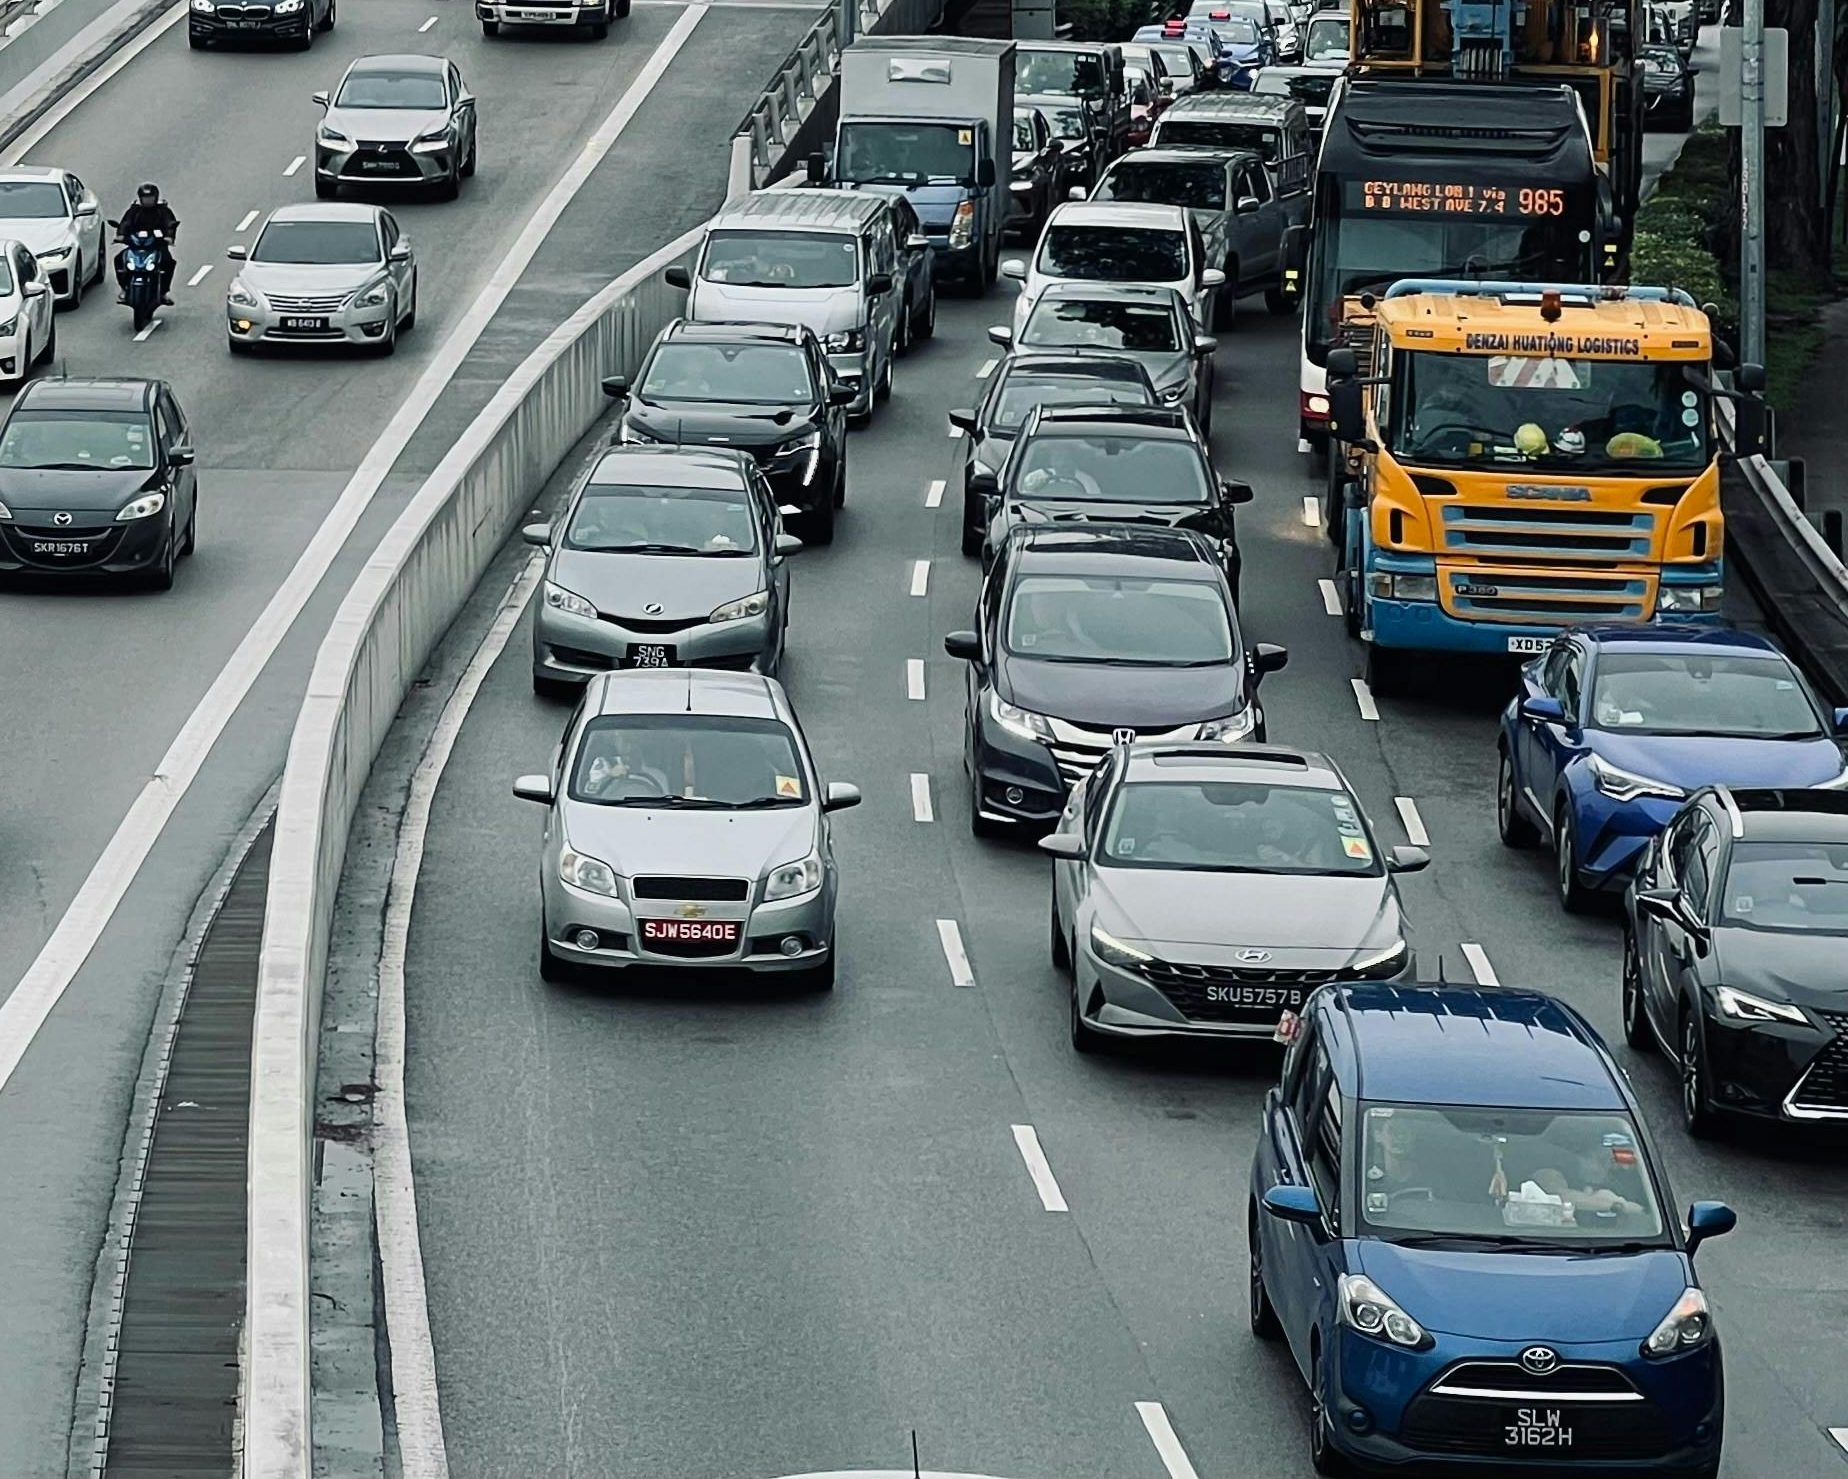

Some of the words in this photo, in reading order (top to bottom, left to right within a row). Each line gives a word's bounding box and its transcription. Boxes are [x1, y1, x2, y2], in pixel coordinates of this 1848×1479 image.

[1364, 181, 1431, 196] GEYLANG
[1435, 184, 1464, 199] LOR
[1482, 187, 1506, 200] via
[1400, 197, 1441, 211] WEST
[1444, 199, 1474, 212] AVE
[1518, 188, 1564, 215] 985
[1465, 333, 1509, 350] DENZAI
[1512, 336, 1574, 353] HUATIONG
[1577, 338, 1640, 355] LOGISTICS
[638, 645, 665, 658] SNG
[644, 922, 736, 940] SJW5640E
[1206, 985, 1303, 1006] SKU5757B
[1517, 1408, 1561, 1427] SLW
[1504, 1426, 1573, 1446] 3162H
